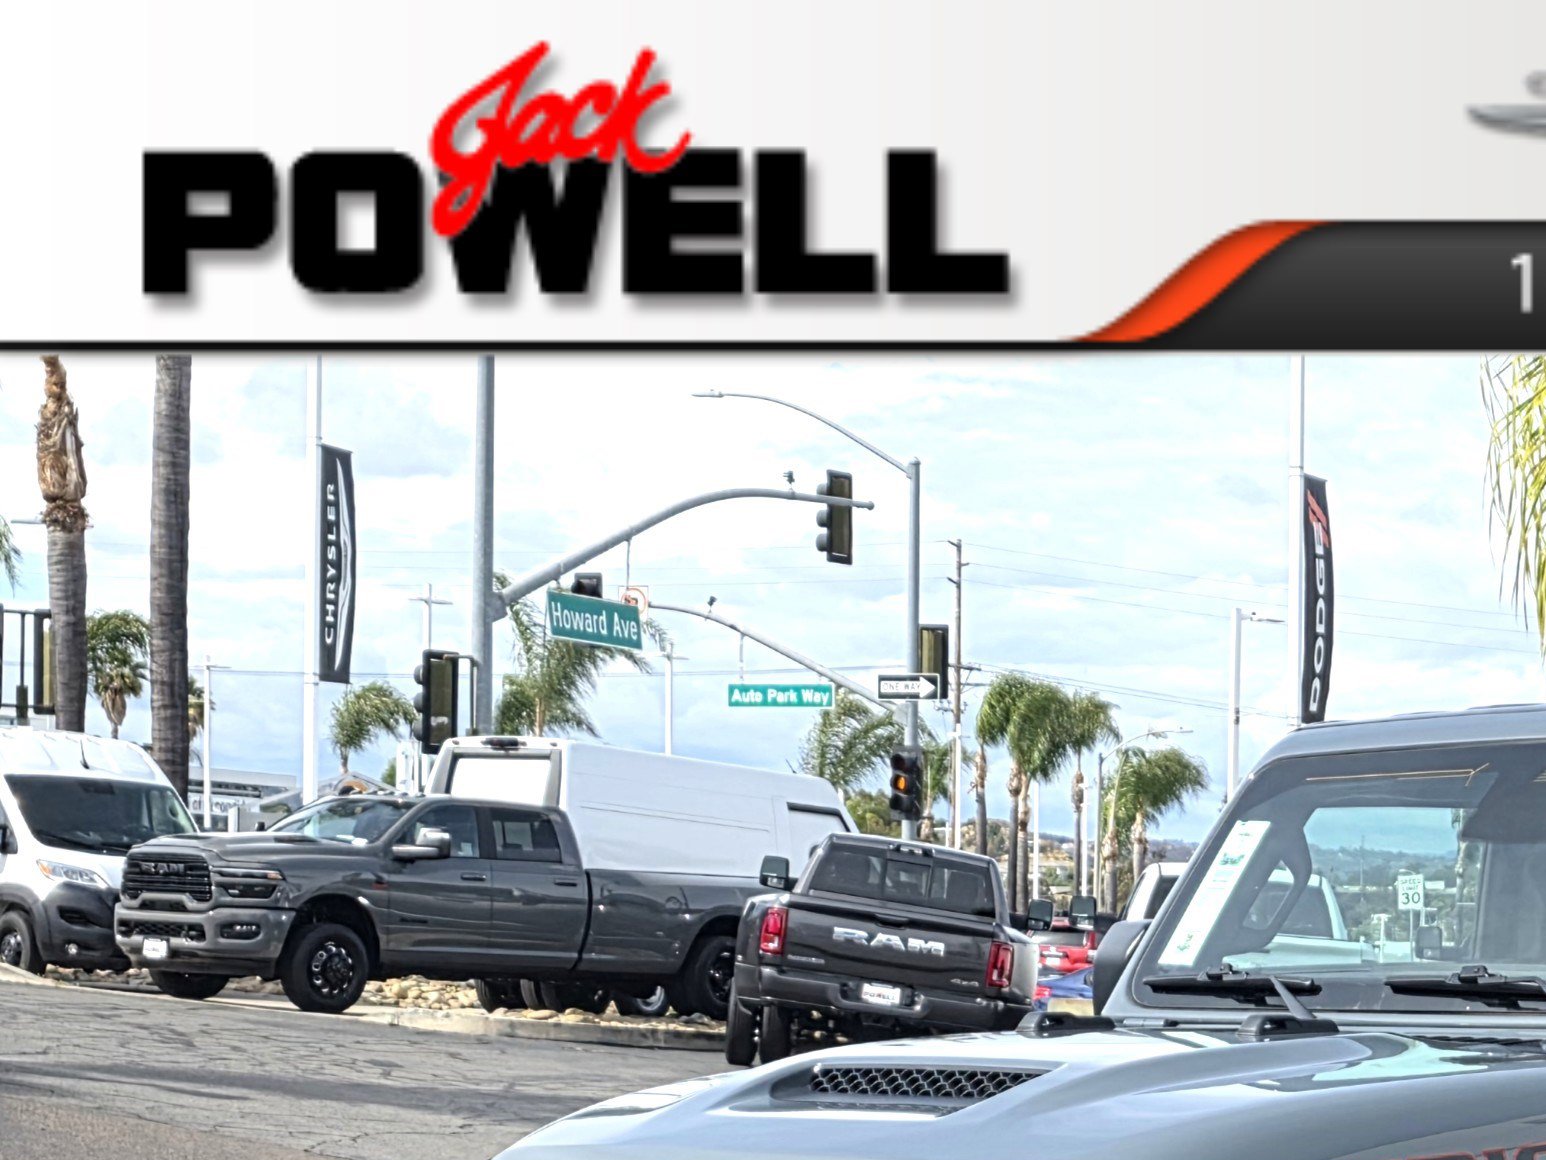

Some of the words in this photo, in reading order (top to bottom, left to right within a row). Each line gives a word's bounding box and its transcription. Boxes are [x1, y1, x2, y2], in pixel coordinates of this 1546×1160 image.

[324, 482, 337, 645] CHRYSLER
[551, 601, 608, 635] Howard
[613, 611, 638, 640] Ave
[1308, 521, 1326, 714] DODGE
[731, 688, 763, 703] Auto
[767, 688, 798, 703] Park
[801, 688, 830, 706] Way
[882, 683, 900, 691] ONE
[904, 683, 921, 691] WAY
[1401, 892, 1420, 905] 30
[832, 926, 946, 957] RAM
